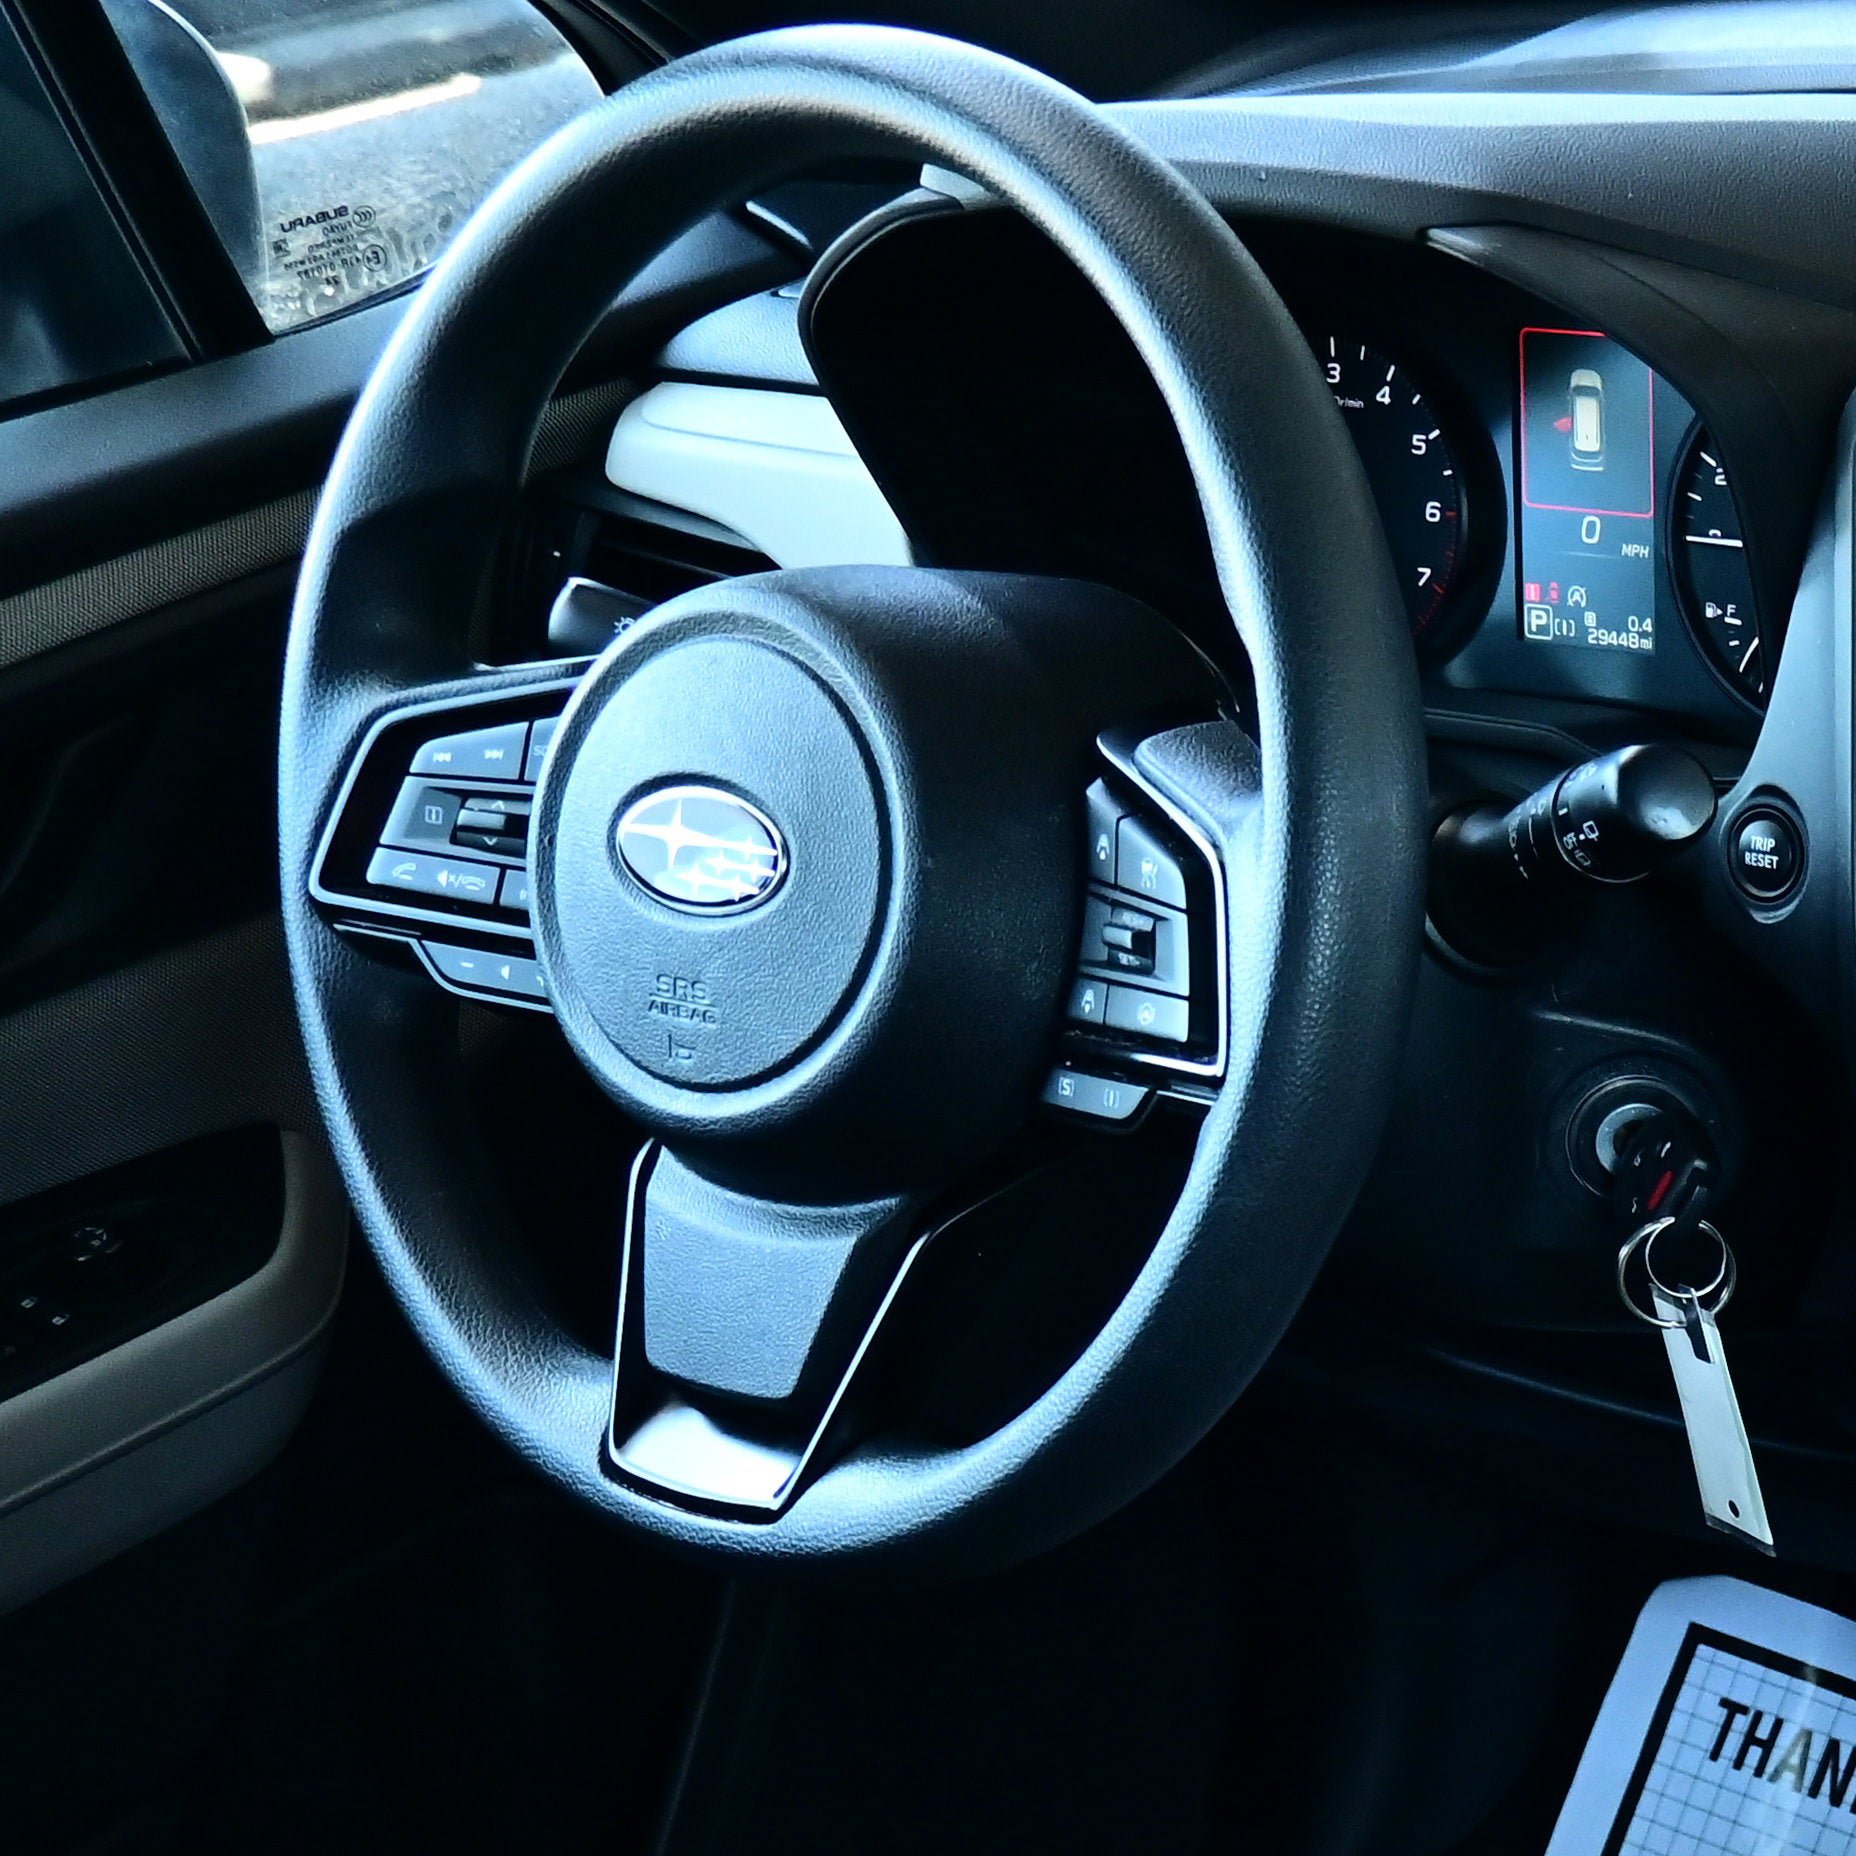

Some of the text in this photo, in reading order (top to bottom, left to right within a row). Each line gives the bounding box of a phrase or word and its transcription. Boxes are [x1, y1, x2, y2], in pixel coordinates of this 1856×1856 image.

[1326, 363, 1341, 383] 3
[1376, 386, 1391, 405] 4
[1411, 434, 1426, 455] 5
[1425, 501, 1441, 522] 6
[1581, 515, 1601, 544] 0
[1621, 544, 1649, 558] MPH
[1417, 567, 1431, 587] 7
[1727, 604, 1737, 617] F
[1628, 616, 1653, 632] 0.4
[1750, 833, 1776, 853] TRIP
[1744, 851, 1779, 870] RESET
[655, 973, 710, 1002] SRS
[648, 999, 717, 1025] AIRBAG
